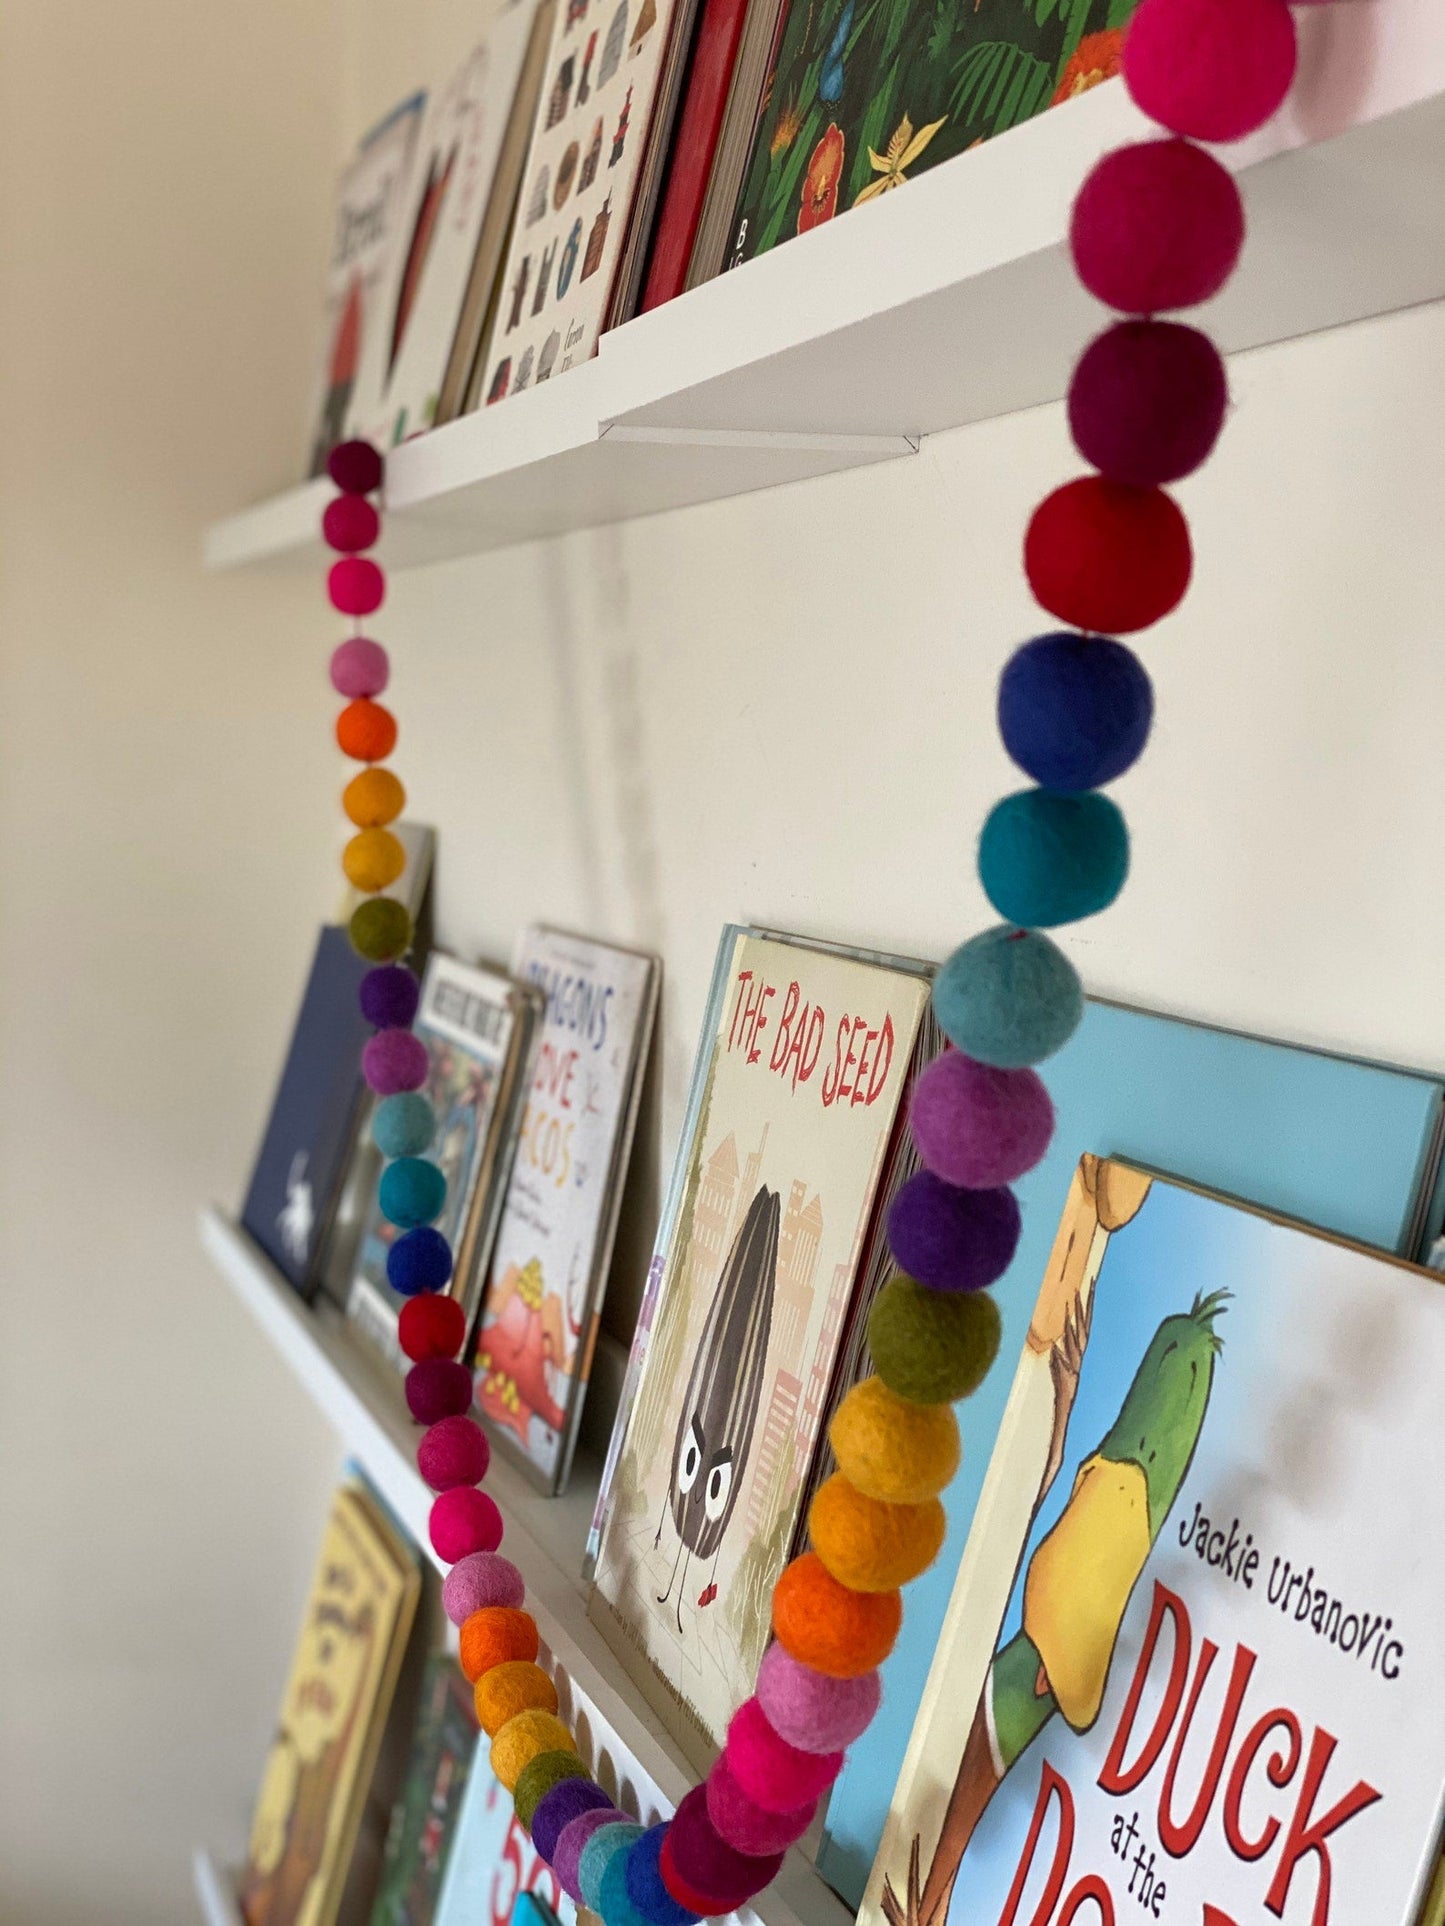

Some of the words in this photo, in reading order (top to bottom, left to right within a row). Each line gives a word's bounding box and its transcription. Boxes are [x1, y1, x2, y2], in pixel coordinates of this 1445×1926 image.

[727, 970, 777, 1065] THE
[769, 981, 825, 1097] BAD
[821, 1010, 895, 1108] SEED
[1179, 1502, 1260, 1589] Jackie
[1267, 1556, 1404, 1680] Urbanovic
[1096, 1578, 1383, 1926] DUCK
[1110, 1812, 1139, 1861] at
[1127, 1845, 1167, 1919] the
